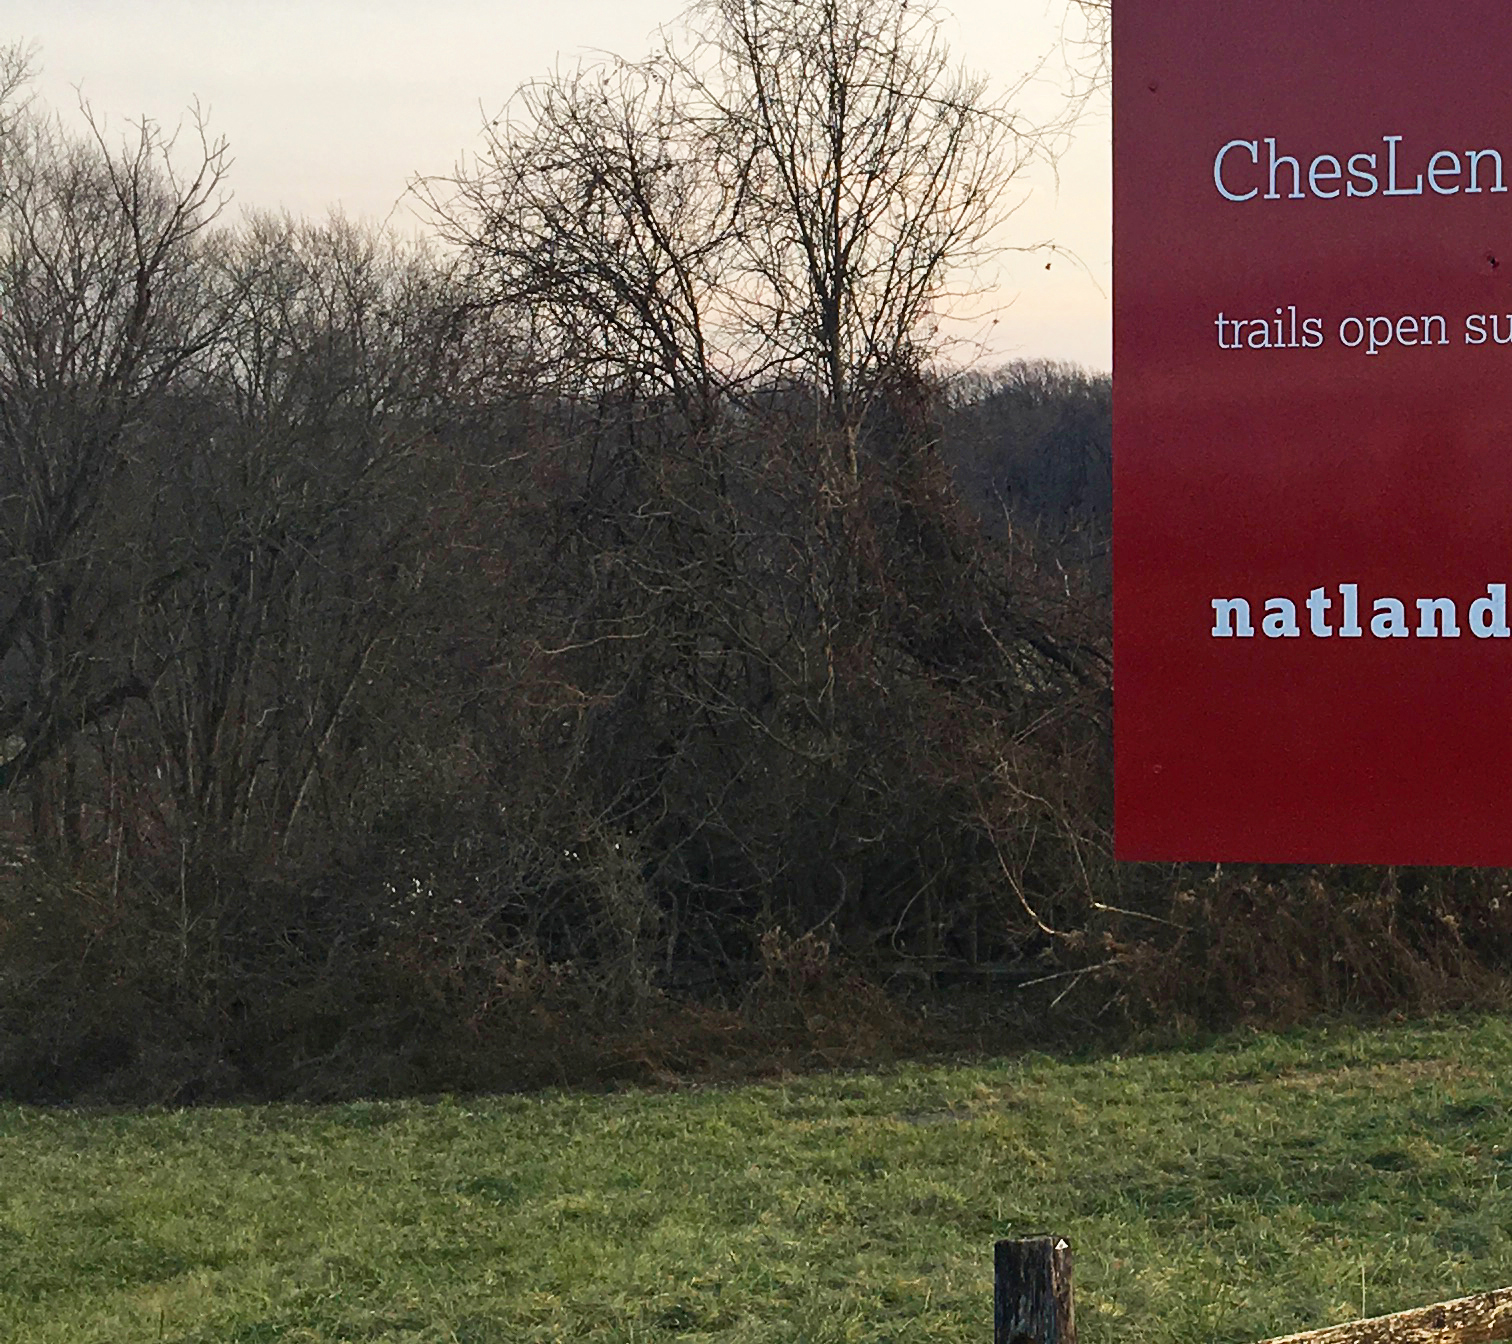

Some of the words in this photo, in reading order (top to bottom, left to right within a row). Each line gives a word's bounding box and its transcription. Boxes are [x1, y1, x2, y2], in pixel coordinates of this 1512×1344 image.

[1212, 134, 1509, 203] ChesLen
[1212, 304, 1325, 350] trails
[1338, 314, 1451, 356] open
